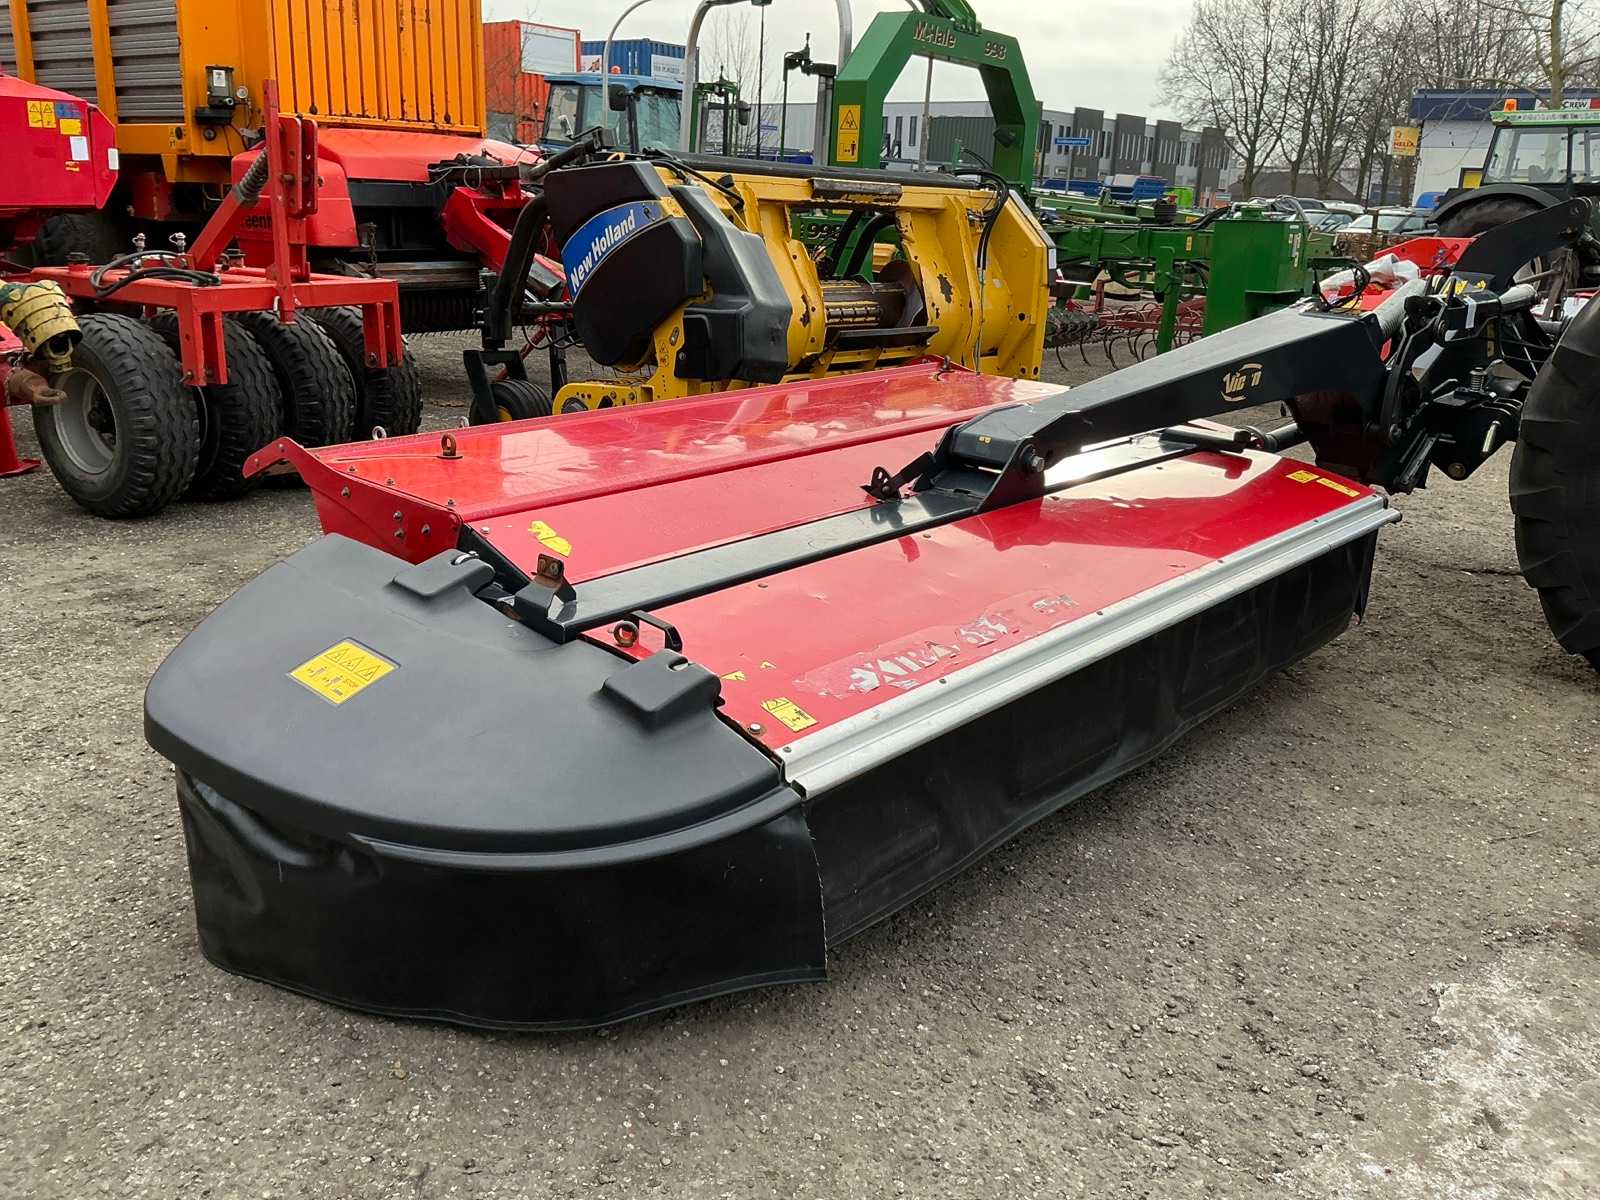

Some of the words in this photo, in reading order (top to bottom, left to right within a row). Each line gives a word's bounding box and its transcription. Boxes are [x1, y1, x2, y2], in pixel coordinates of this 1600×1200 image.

[984, 41, 1006, 59] 998
[1562, 100, 1588, 110] CREW
[570, 249, 593, 293] New
[591, 209, 636, 264] Holland
